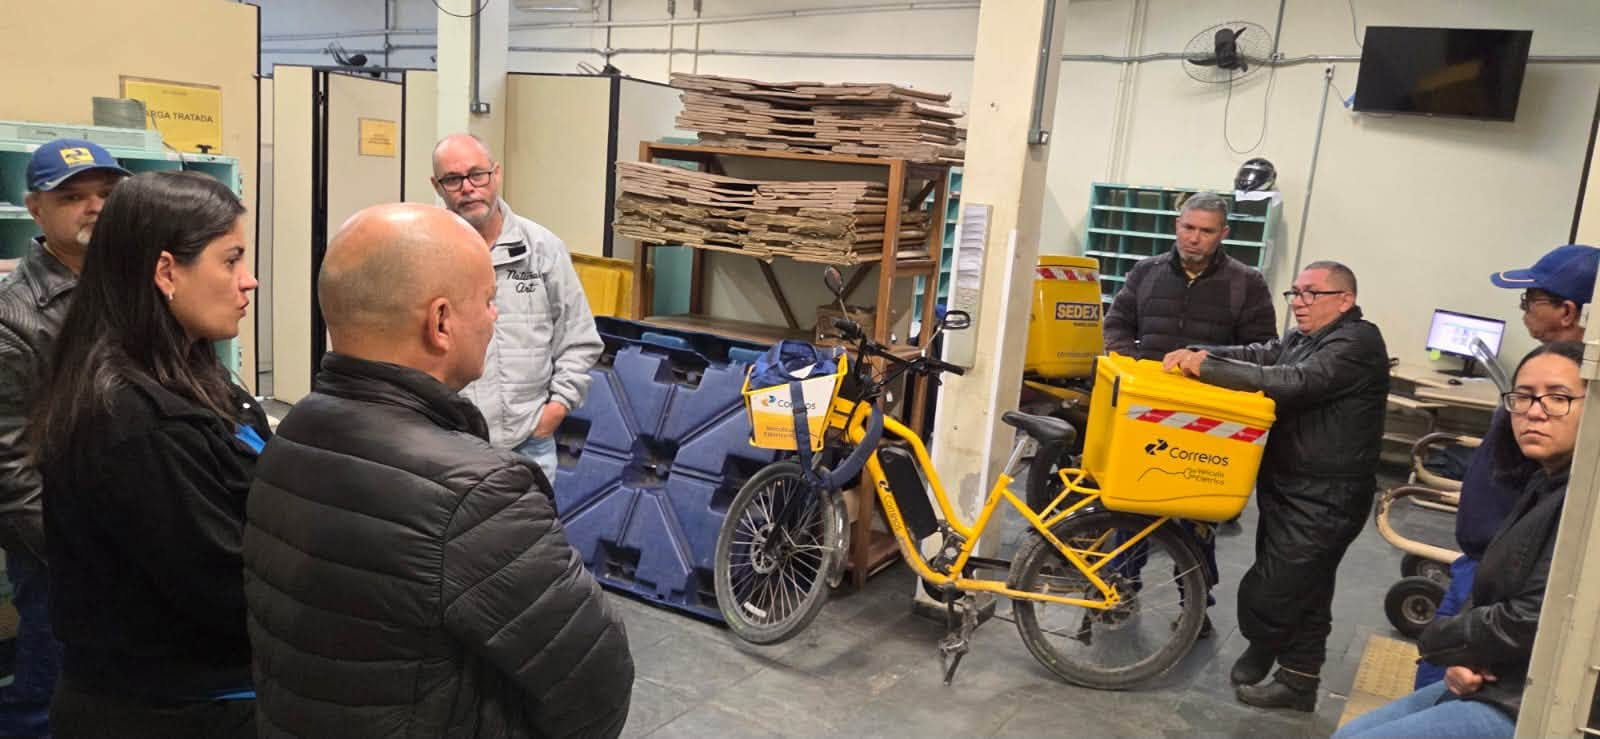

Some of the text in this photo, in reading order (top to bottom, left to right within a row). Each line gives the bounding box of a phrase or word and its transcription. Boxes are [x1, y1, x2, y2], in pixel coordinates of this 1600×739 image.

[145, 110, 214, 122] ARGA TRATADA
[1057, 303, 1099, 320] SEDEX
[777, 399, 816, 410] Coros
[1169, 447, 1229, 466] Correios
